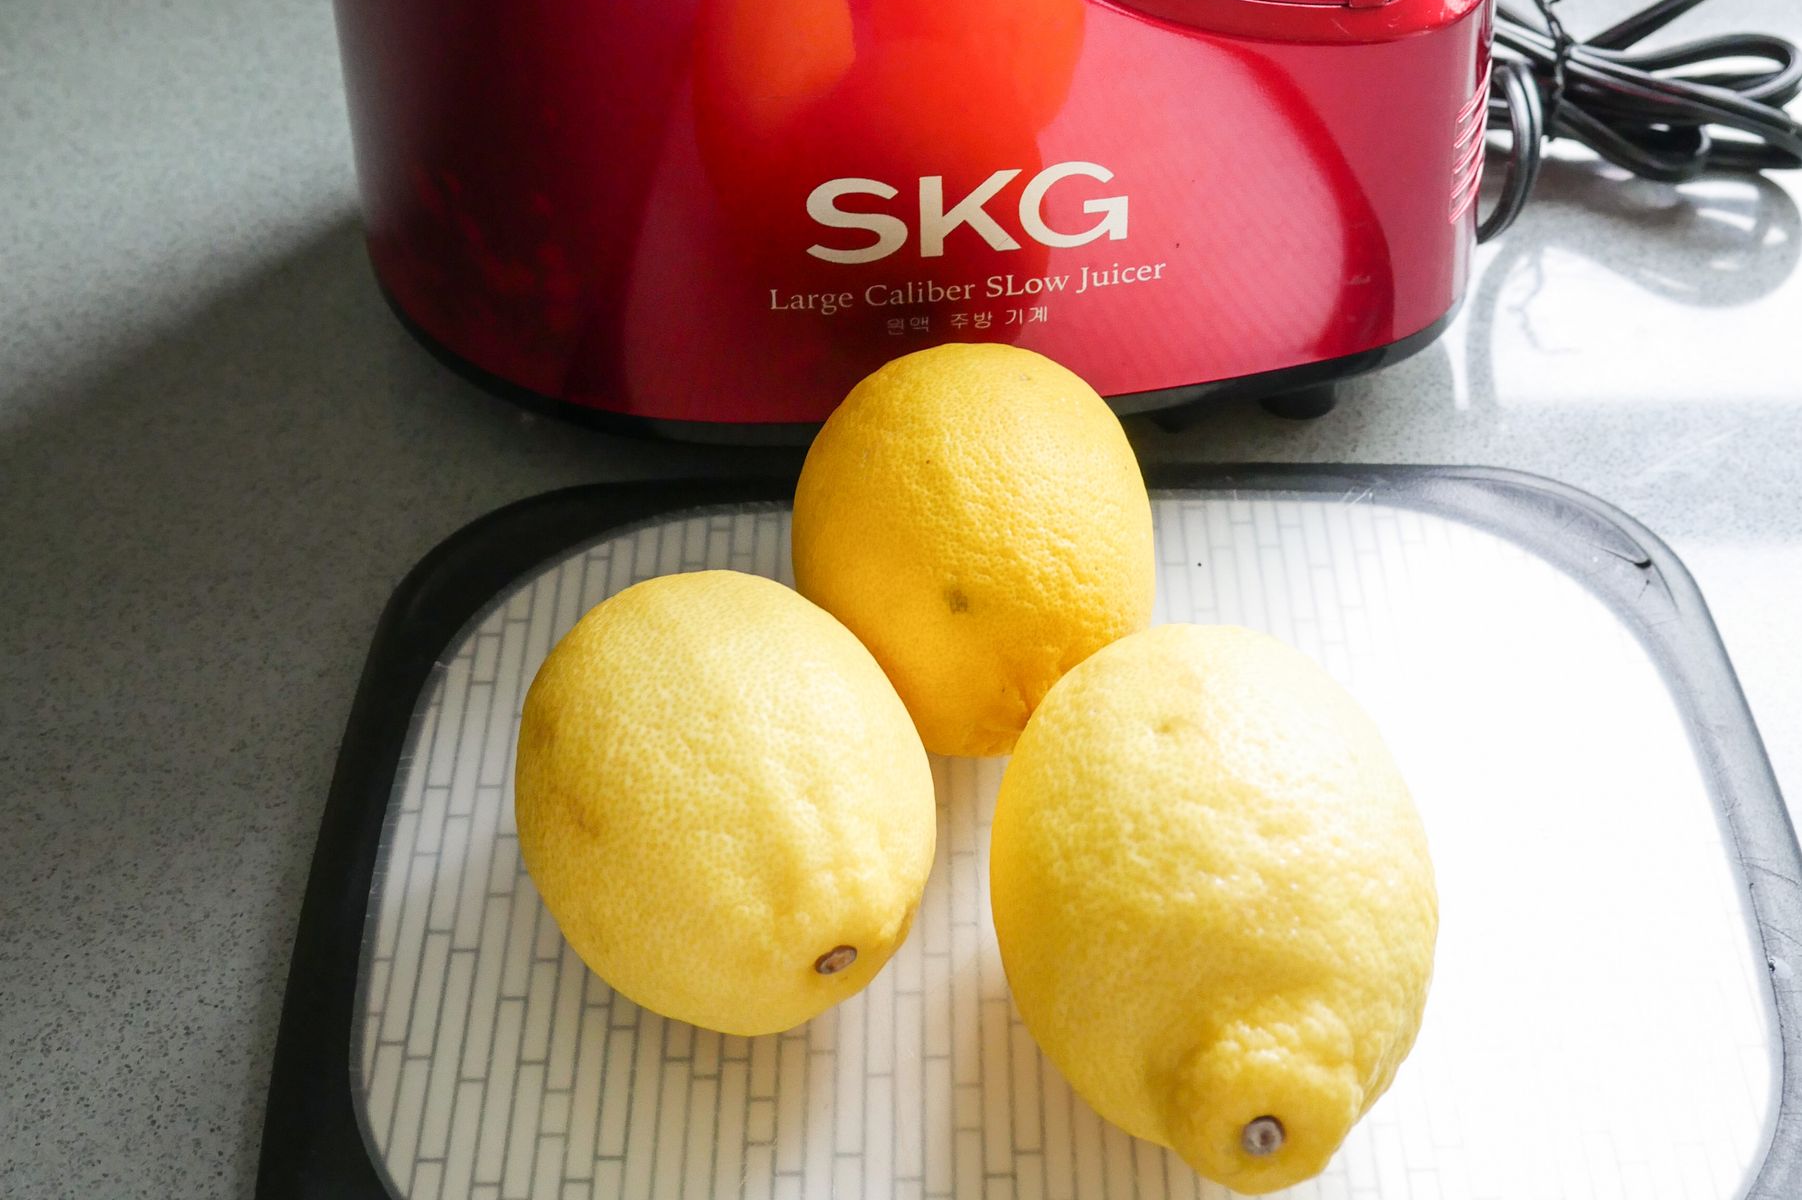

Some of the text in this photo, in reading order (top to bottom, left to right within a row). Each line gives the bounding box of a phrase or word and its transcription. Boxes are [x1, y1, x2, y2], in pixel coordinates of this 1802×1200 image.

[805, 160, 1129, 264] SKG
[769, 261, 1167, 316] Large Caliber SLow Juicer
[950, 311, 993, 330] 주방
[1004, 305, 1049, 326] 기계
